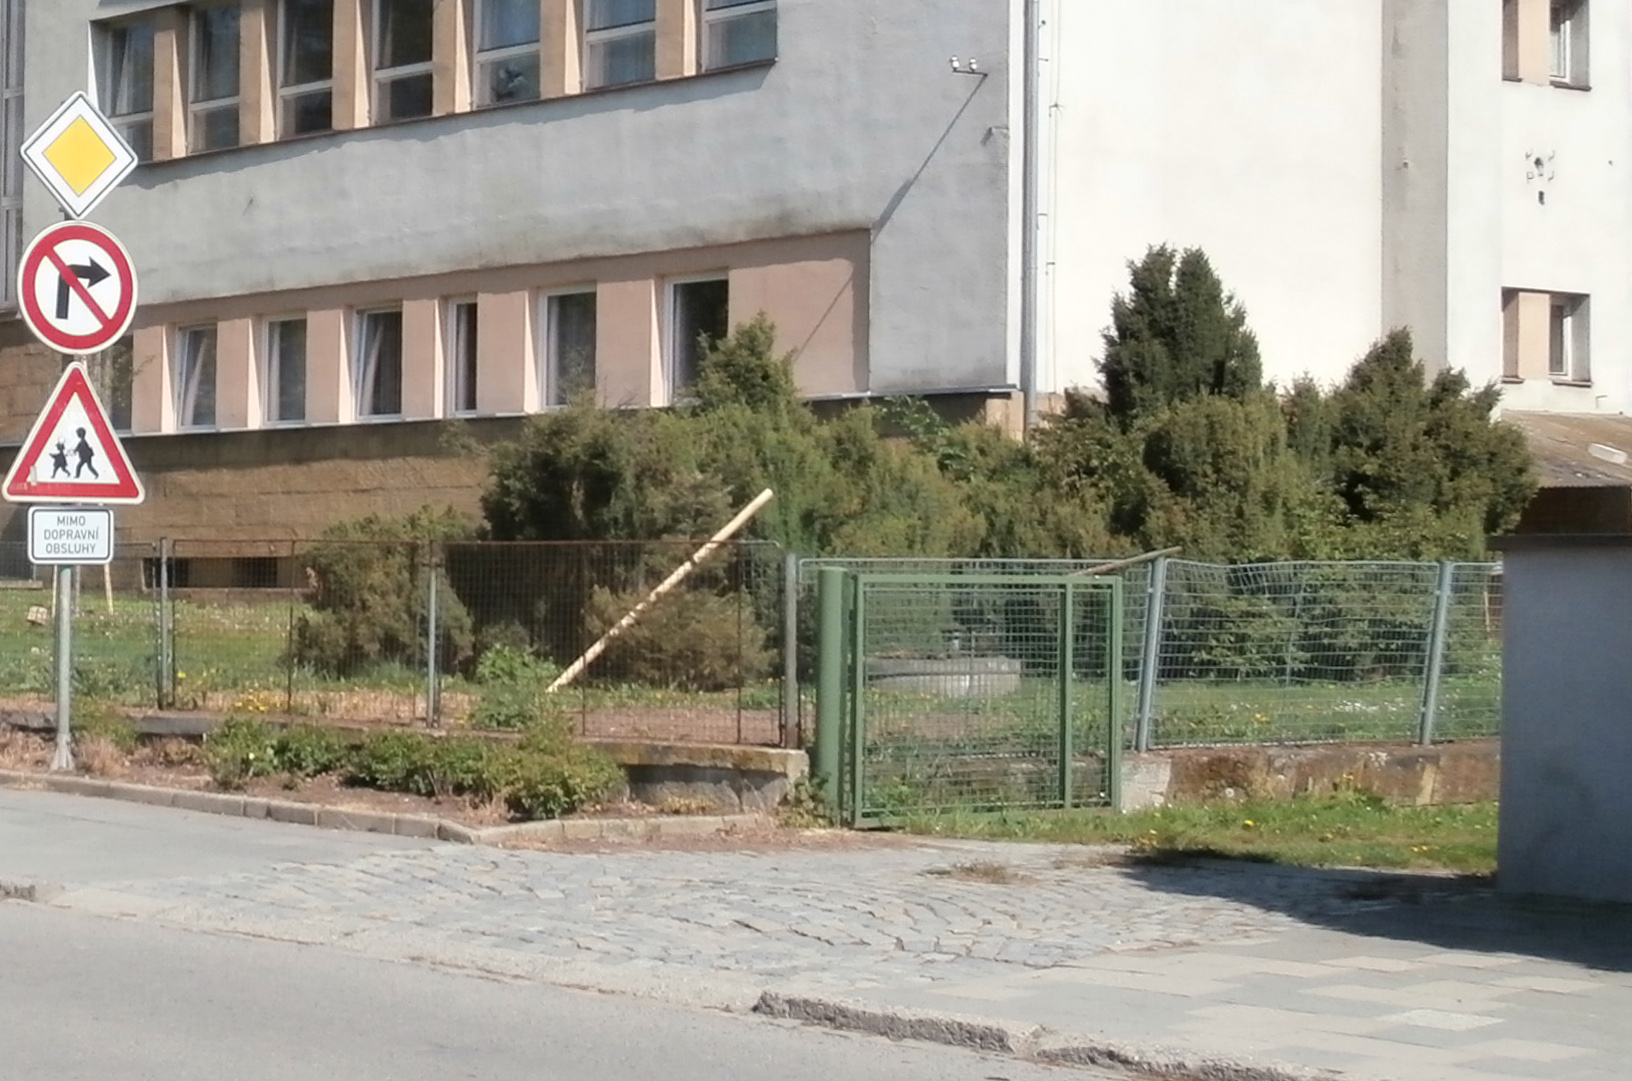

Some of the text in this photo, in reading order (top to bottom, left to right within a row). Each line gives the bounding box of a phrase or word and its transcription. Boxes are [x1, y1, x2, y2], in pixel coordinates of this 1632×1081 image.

[57, 516, 86, 526] MIMO
[44, 527, 99, 540] DOPRAVNÍ
[46, 543, 96, 554] OBSLUHY
